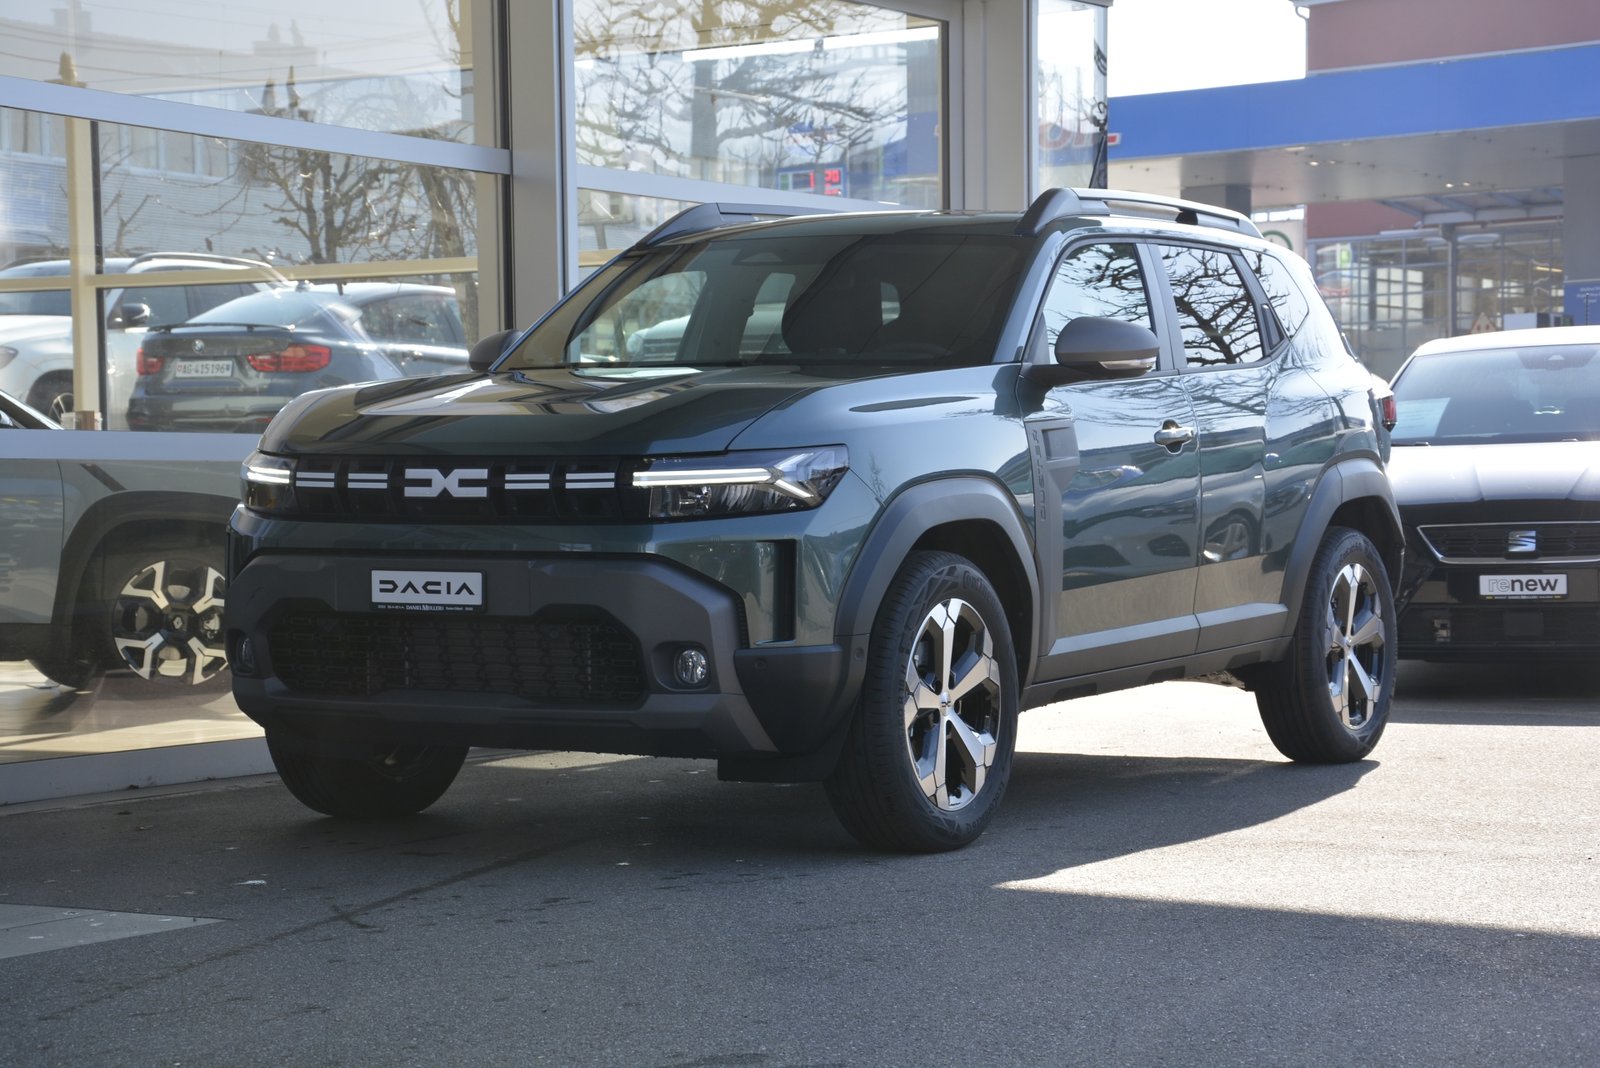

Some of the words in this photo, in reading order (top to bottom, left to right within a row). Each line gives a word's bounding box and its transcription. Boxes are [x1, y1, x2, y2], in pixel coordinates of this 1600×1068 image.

[1032, 429, 1047, 520] DUSTER
[379, 580, 475, 596] DACIA
[1488, 578, 1559, 593] renew
